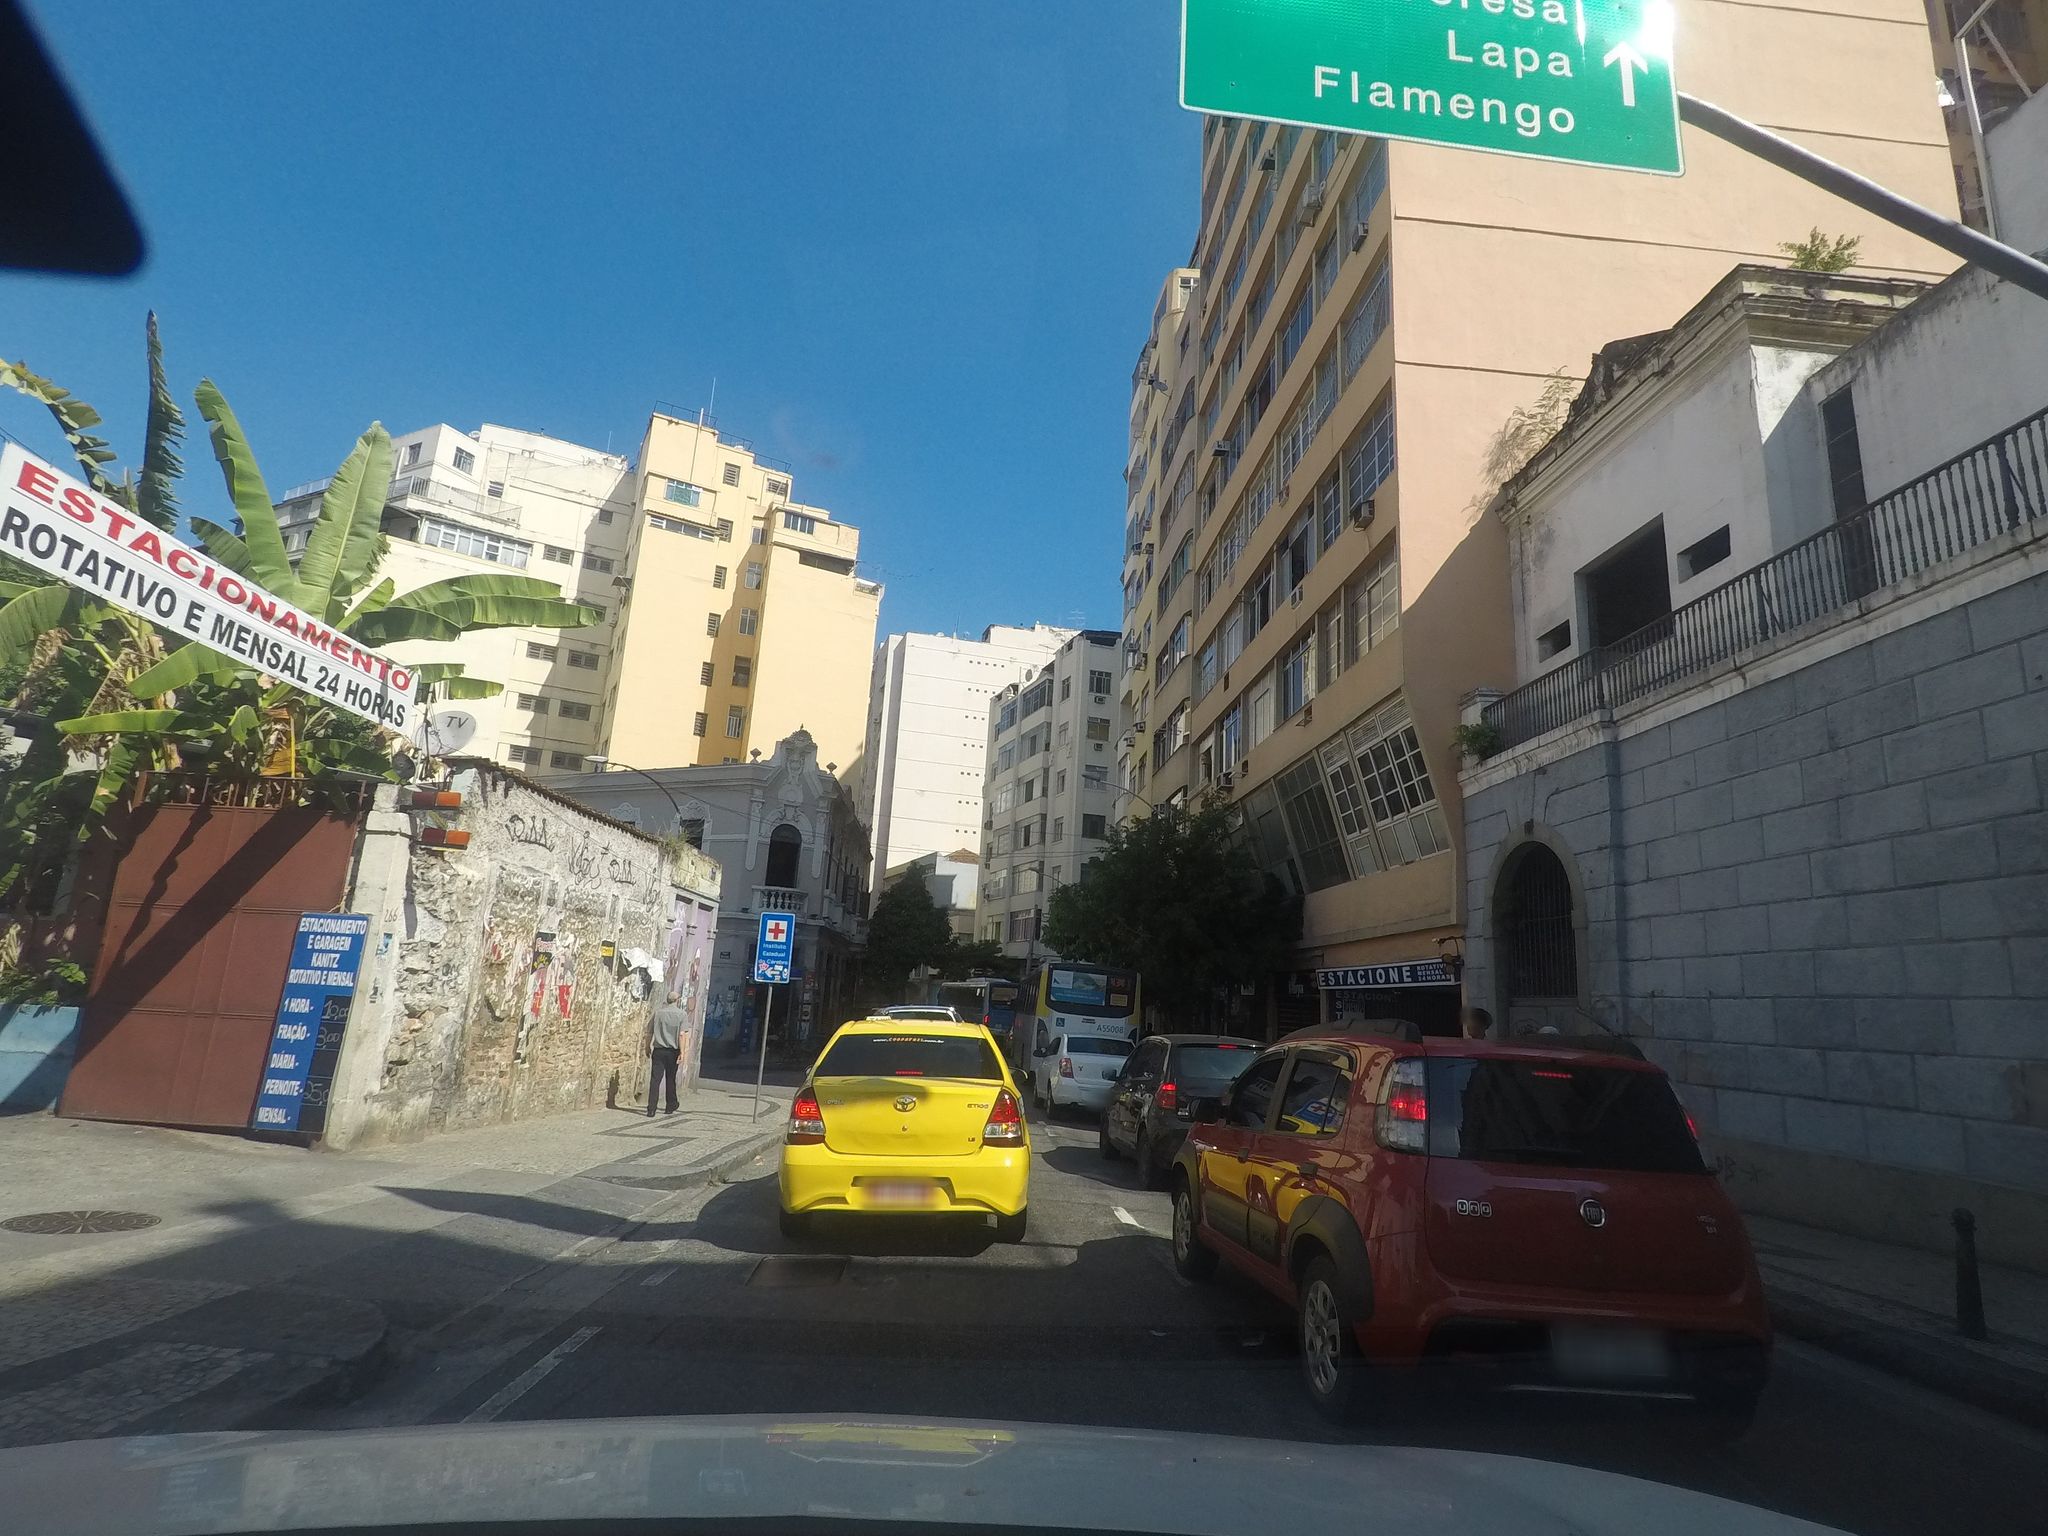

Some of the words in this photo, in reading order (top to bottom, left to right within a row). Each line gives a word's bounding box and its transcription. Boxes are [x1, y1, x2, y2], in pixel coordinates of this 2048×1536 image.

[1448, 30, 1574, 79] Lapa
[1314, 65, 1576, 137] Flamengo
[17, 460, 412, 693] ESTACIONAMENTO
[0, 505, 175, 619] ROTATIVO
[184, 602, 206, 633] E
[209, 614, 308, 684] MENSAL
[315, 665, 339, 698] 24
[345, 679, 405, 728] HORAS
[446, 715, 469, 728] TV
[299, 917, 367, 935] ESTACIONAMENTO
[307, 935, 315, 949] E
[314, 935, 352, 951] GARAGEM
[311, 952, 340, 968] KANITZ
[1416, 963, 1446, 971] ROTATIV
[288, 968, 321, 985] ROTATIVO
[320, 970, 328, 985] E
[326, 971, 354, 987] MENSAL
[1318, 967, 1412, 986] ESTACIONE
